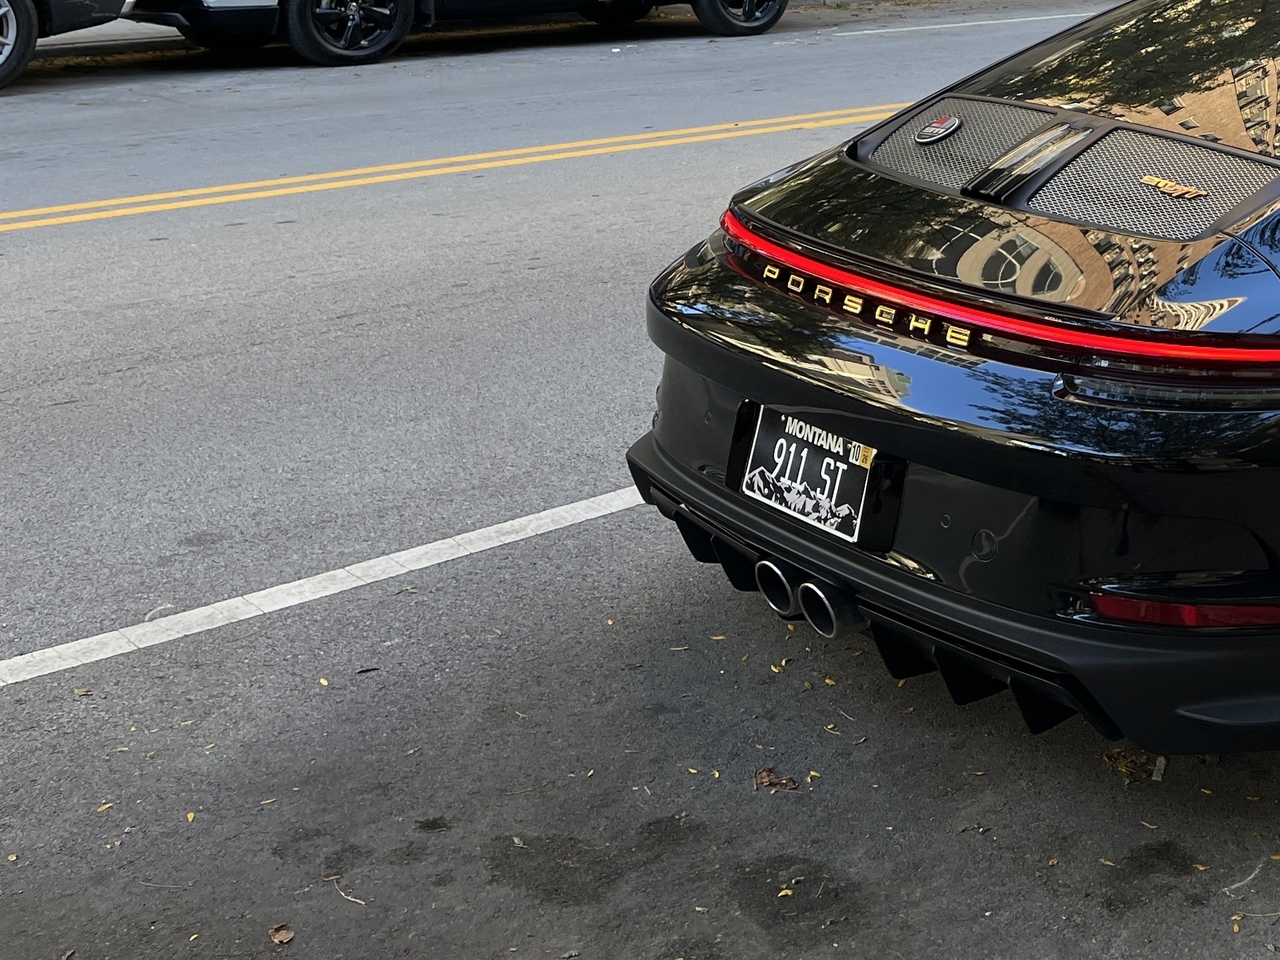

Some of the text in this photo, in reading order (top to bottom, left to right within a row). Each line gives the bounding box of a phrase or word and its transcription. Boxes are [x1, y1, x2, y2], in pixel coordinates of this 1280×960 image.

[763, 264, 971, 346] PORSCHE
[785, 416, 844, 456] MONTANA
[852, 444, 861, 462] 10
[771, 438, 848, 507] 911 ST
